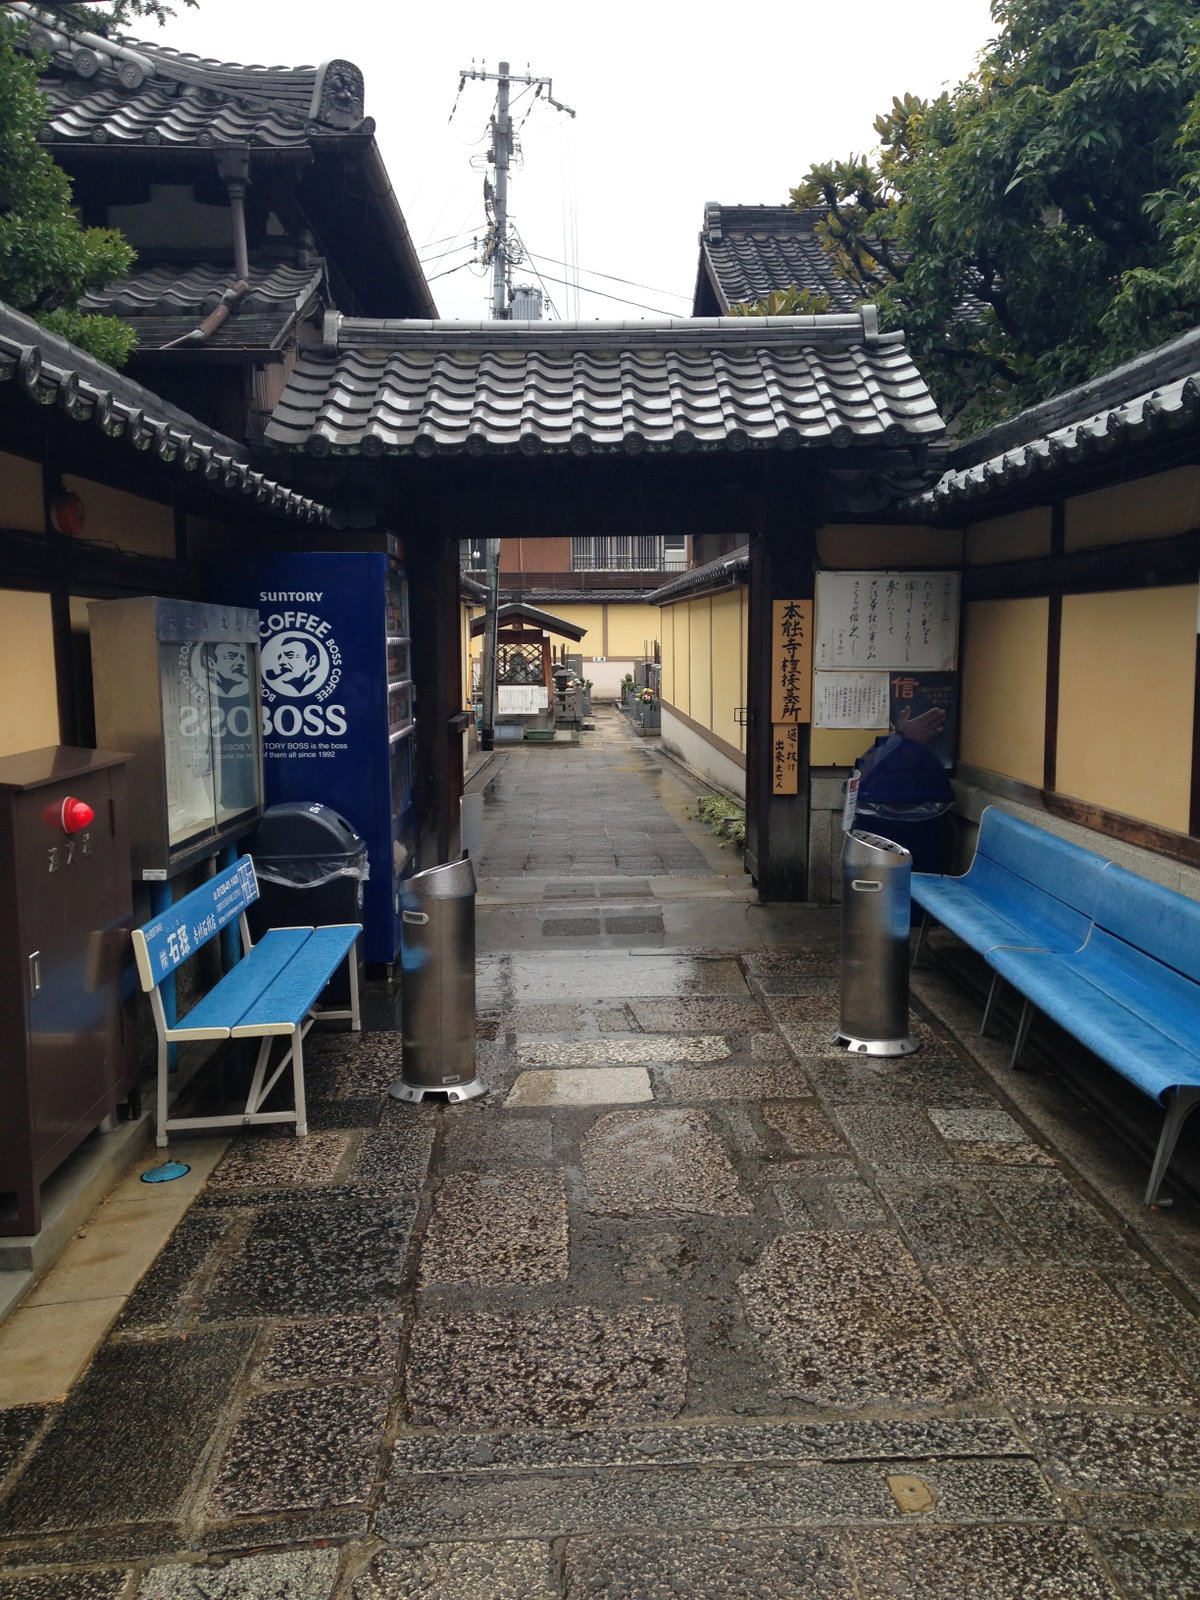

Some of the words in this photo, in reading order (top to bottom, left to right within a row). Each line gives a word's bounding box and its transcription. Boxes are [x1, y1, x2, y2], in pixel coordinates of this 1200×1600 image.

[259, 611, 332, 639] COFFEE
[325, 638, 343, 666] BOSS
[781, 601, 805, 723] 本能寺檀徒墓所
[314, 668, 342, 702] COFFEE
[891, 677, 920, 699] 信
[287, 742, 310, 750] BOSS
[310, 742, 317, 750] is
[318, 742, 329, 750] the
[330, 742, 348, 750] boss
[786, 727, 798, 772] 通り抜け
[774, 740, 785, 789] 出来ません
